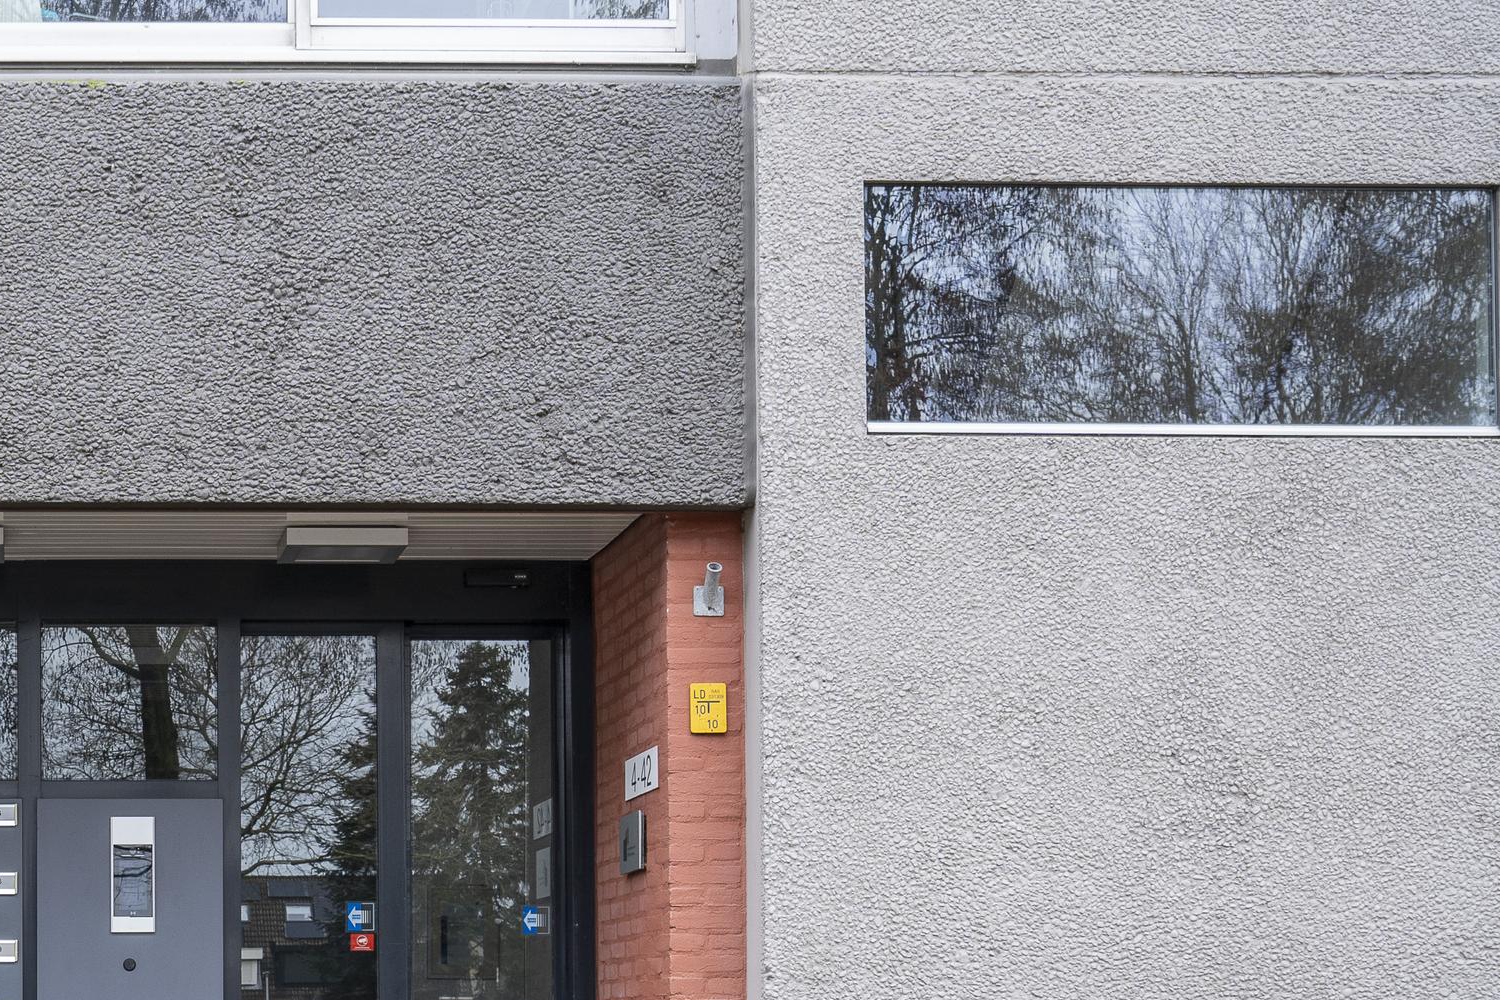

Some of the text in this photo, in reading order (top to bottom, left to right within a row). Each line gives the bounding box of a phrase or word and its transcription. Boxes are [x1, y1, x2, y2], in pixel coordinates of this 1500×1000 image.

[693, 689, 706, 699] LD
[695, 704, 706, 715] 10
[707, 719, 718, 729] 10
